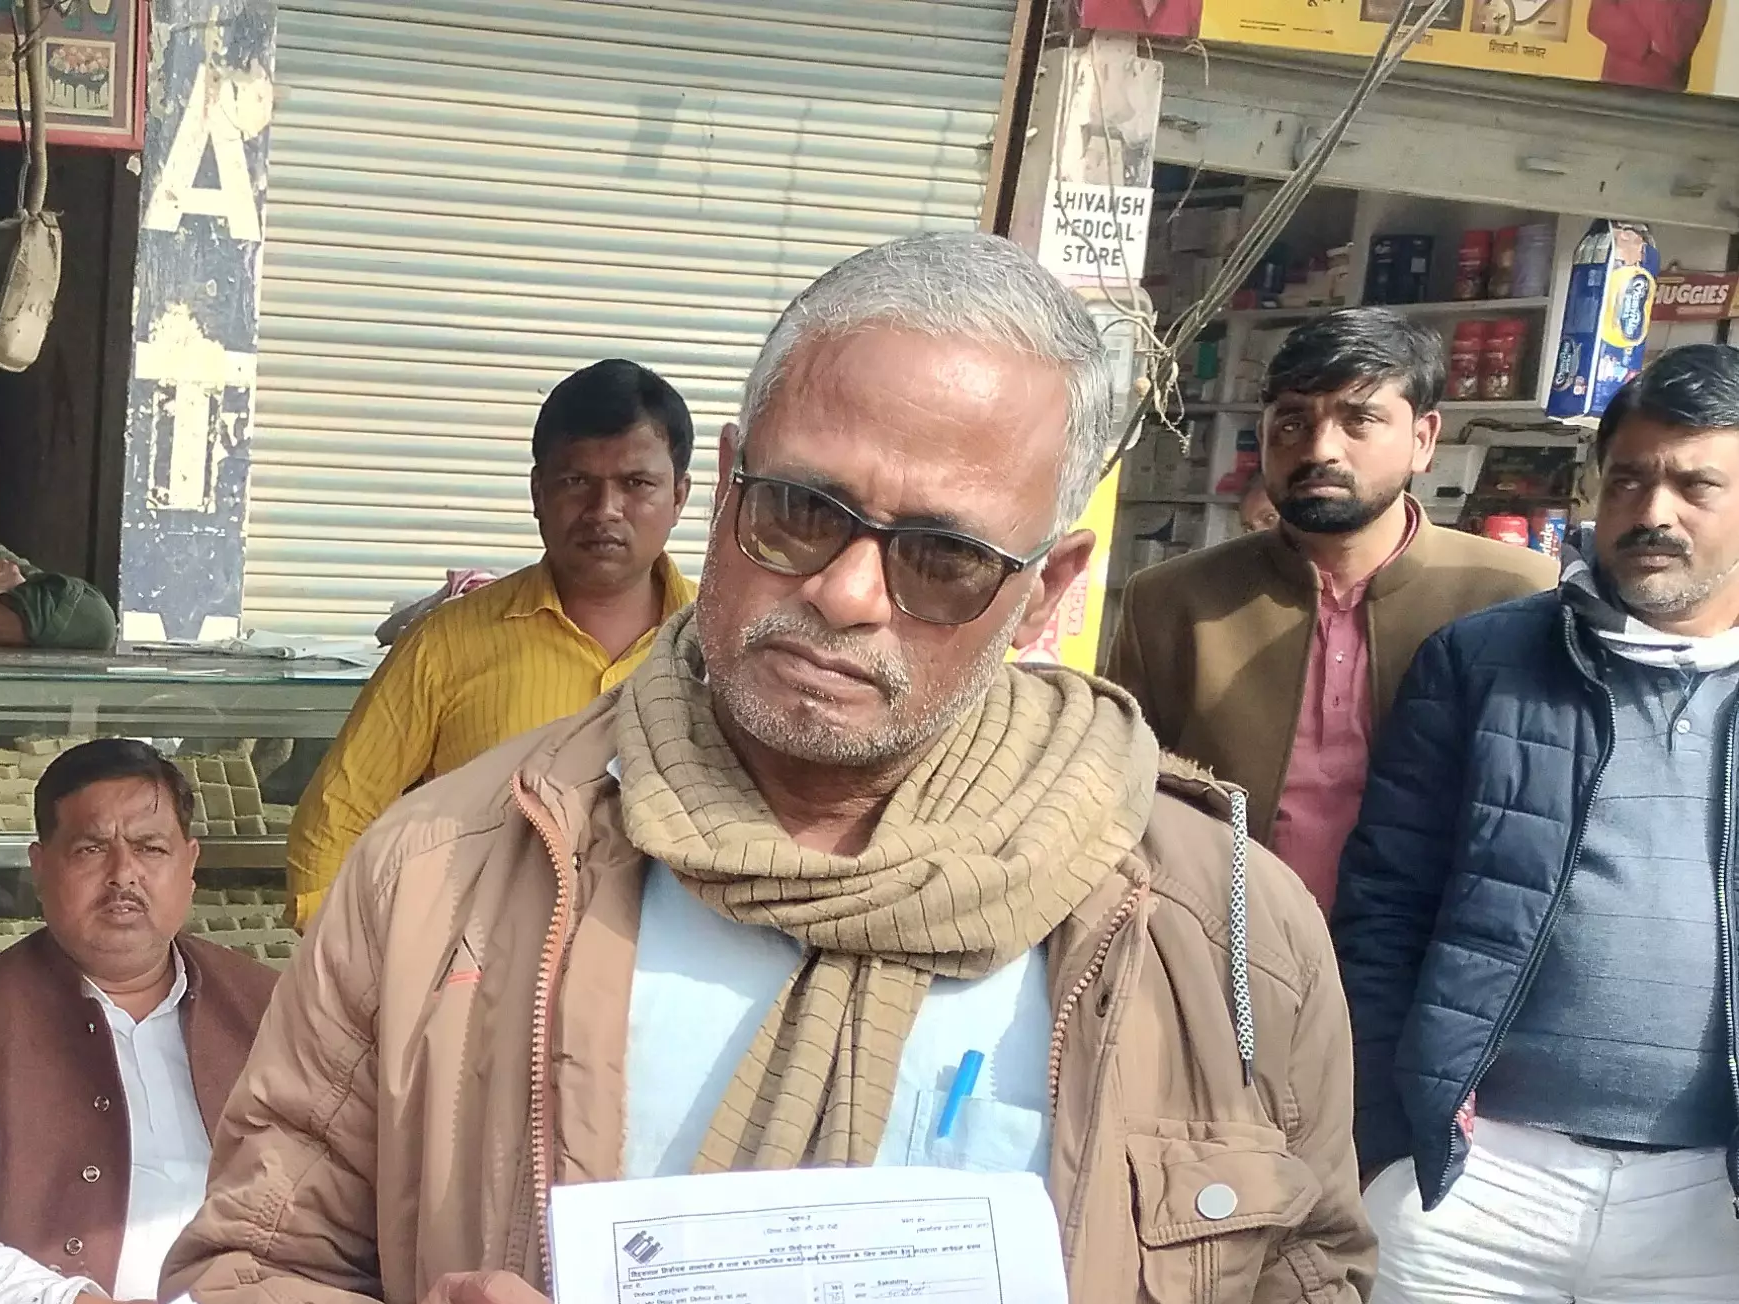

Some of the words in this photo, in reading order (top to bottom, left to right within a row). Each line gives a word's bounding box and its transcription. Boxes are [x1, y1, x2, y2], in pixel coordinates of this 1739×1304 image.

[1053, 190, 1145, 216] SHIVANSH
[1055, 217, 1135, 242] MEDICAL
[1062, 244, 1122, 267] STORE
